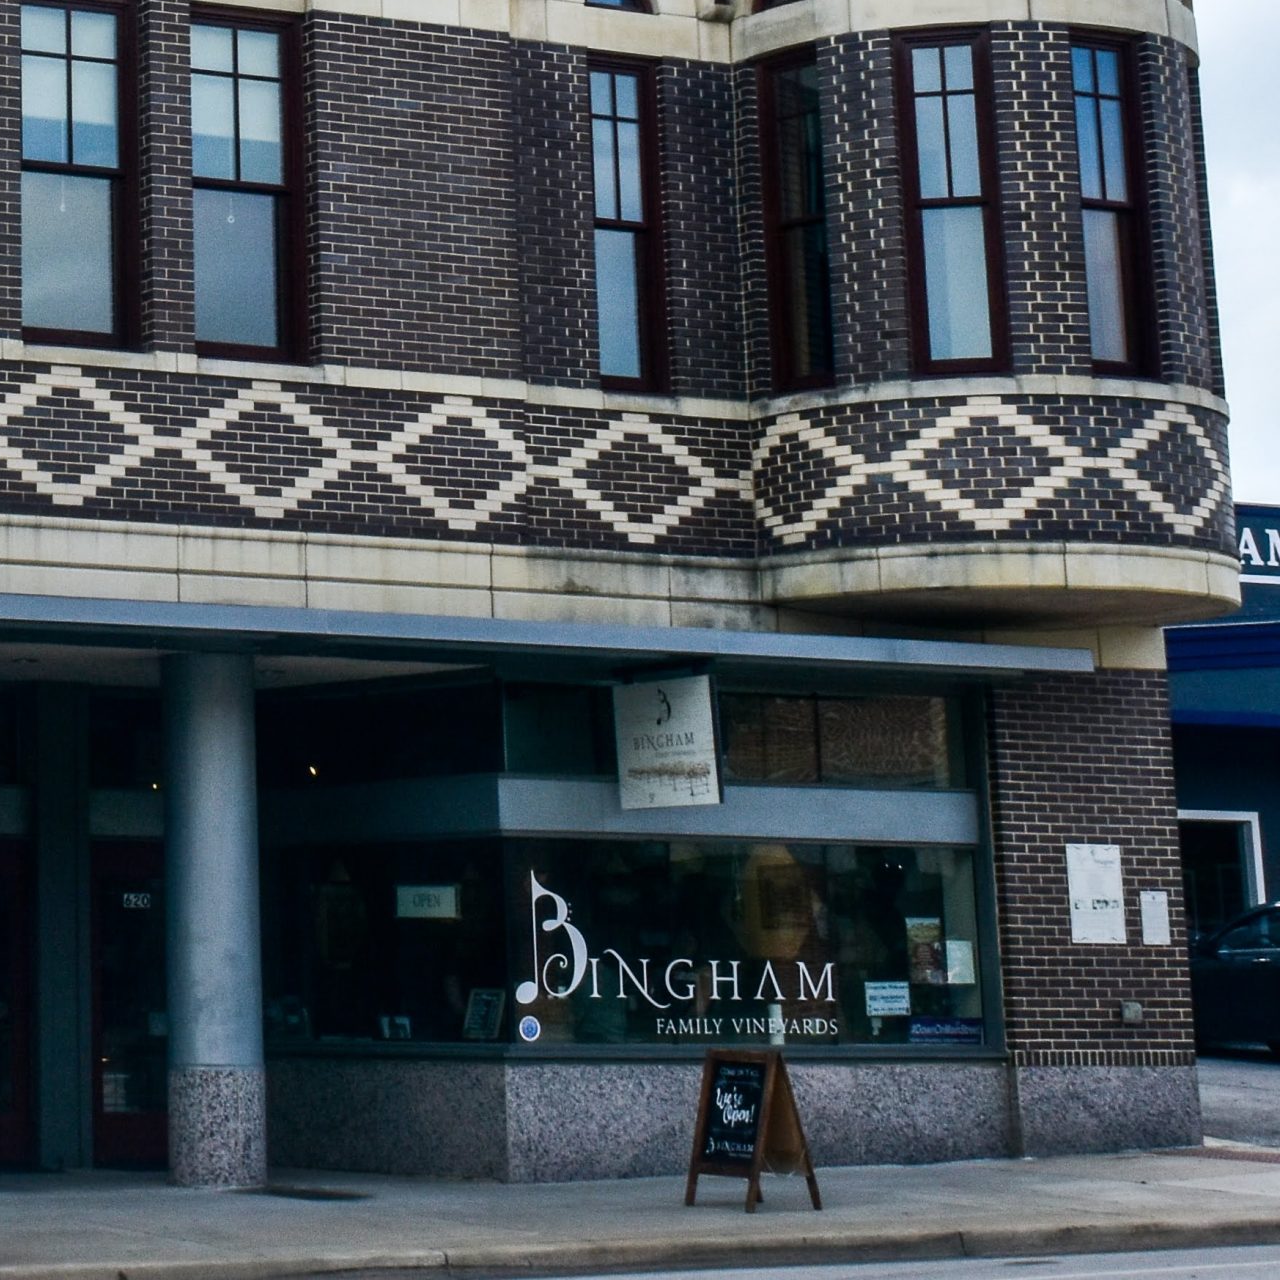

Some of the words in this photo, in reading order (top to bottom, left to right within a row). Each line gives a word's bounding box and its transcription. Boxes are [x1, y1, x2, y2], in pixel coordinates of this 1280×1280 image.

[633, 732, 695, 751] BINGHAM
[123, 894, 150, 907] 620
[412, 893, 441, 908] OPEN
[516, 870, 837, 1009] BINGHAM
[656, 1017, 723, 1035] FAMILY
[732, 1018, 838, 1035] VINEYARDS
